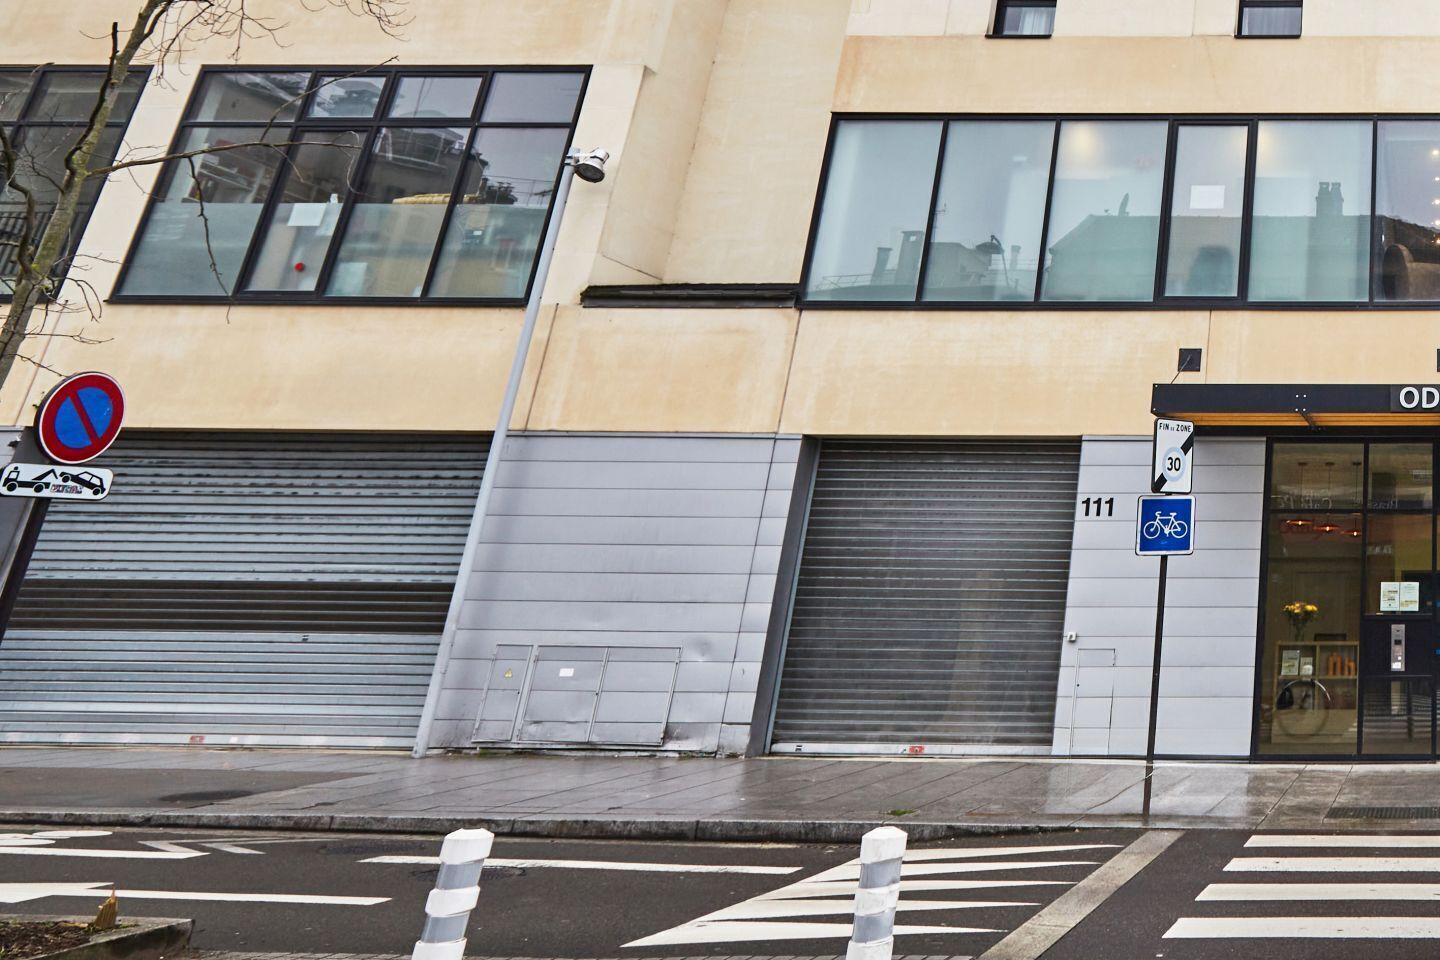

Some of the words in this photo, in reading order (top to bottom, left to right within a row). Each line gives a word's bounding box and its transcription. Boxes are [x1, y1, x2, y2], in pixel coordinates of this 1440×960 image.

[1159, 422, 1170, 431] FIN
[1176, 424, 1192, 433] ZONE
[1167, 456, 1181, 471] 30
[1081, 497, 1114, 517] 111
